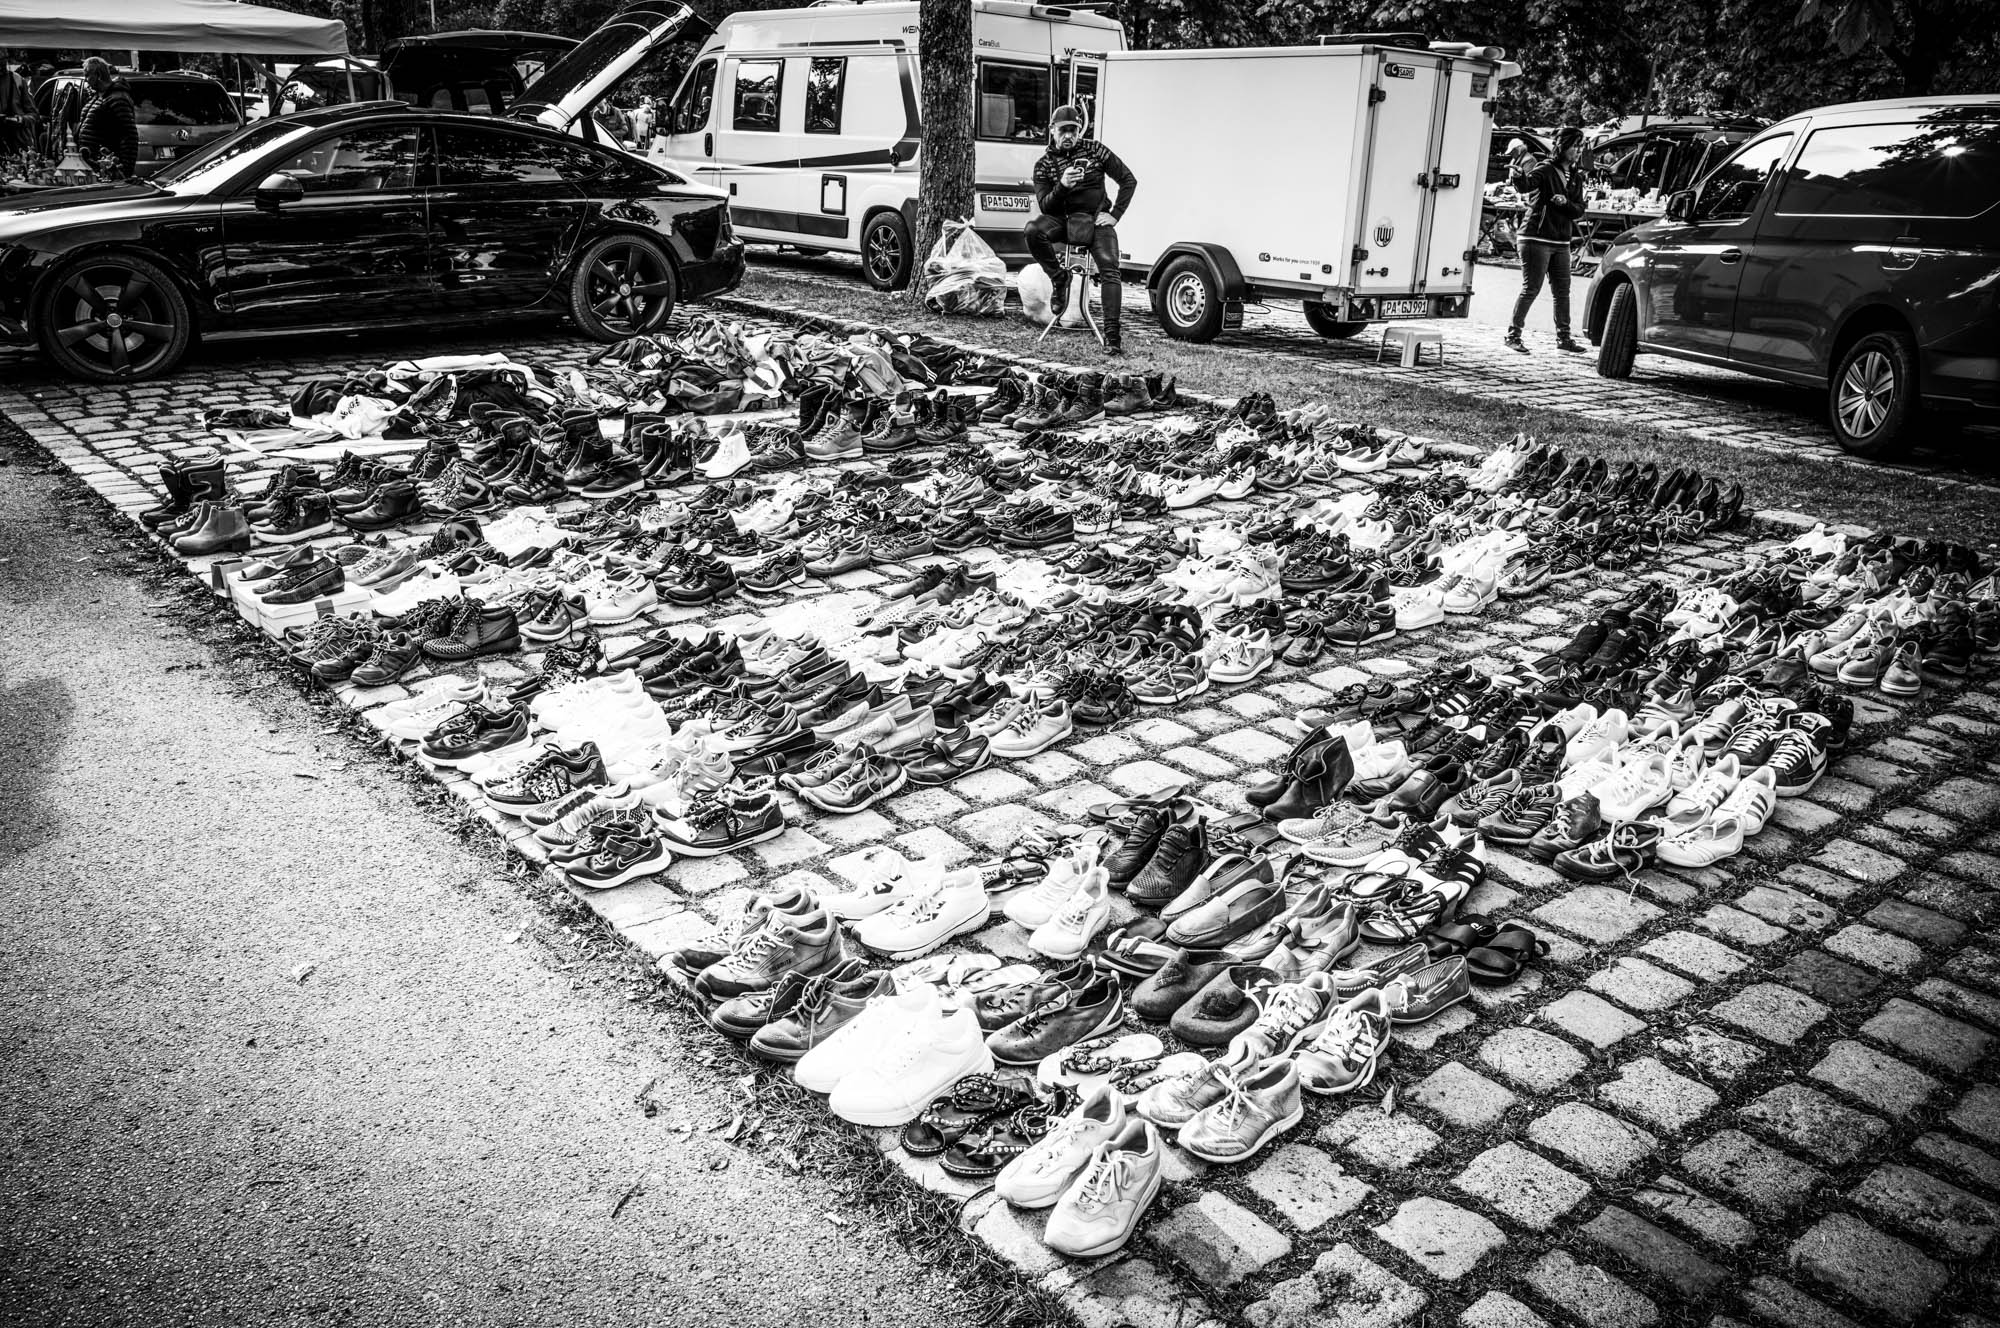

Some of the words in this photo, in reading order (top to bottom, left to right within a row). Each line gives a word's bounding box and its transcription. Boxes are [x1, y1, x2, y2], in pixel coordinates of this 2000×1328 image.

[1399, 68, 1415, 77] SARIS
[987, 196, 999, 206] PA
[1386, 301, 1397, 314] PA
